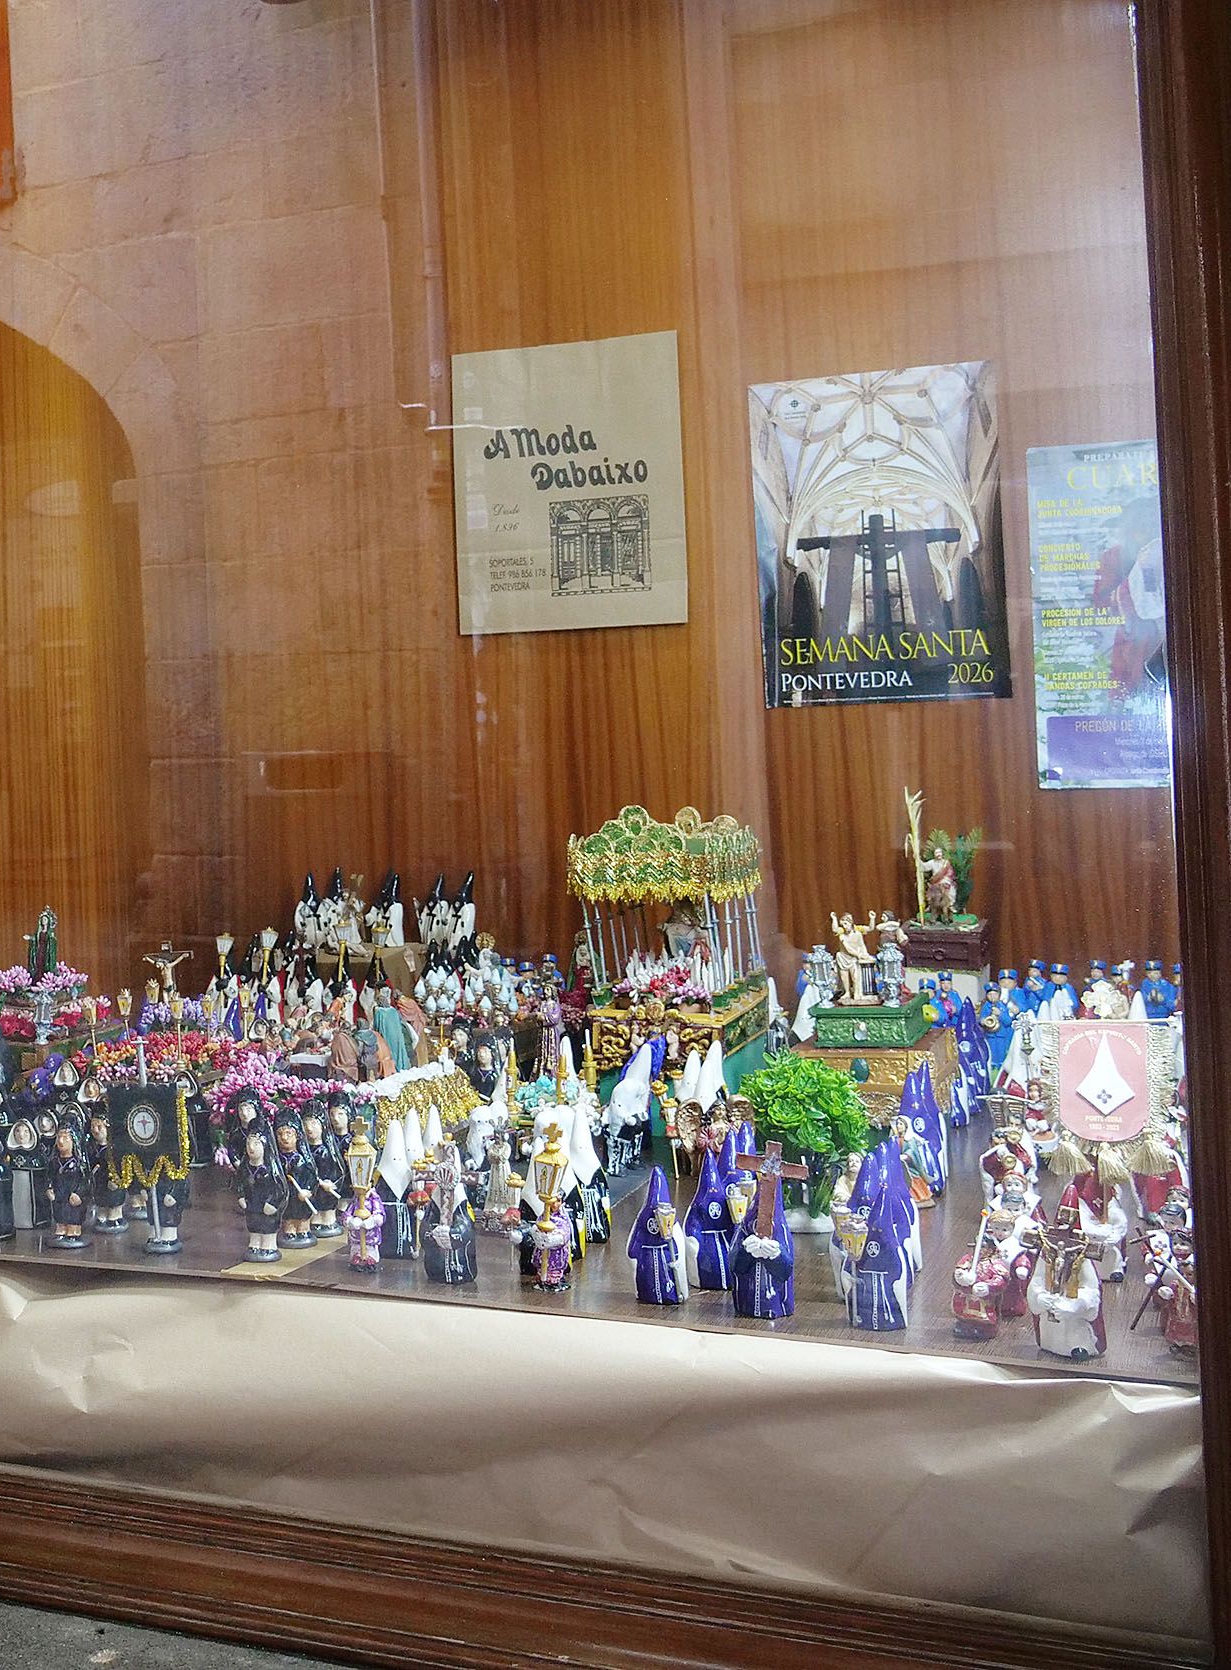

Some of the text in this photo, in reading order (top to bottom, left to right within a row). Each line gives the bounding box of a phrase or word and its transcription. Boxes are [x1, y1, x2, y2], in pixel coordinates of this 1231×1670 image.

[483, 424, 598, 459] A Moda
[531, 457, 648, 491] Dabaixo
[490, 581, 530, 593] PONTEVEDRA
[780, 628, 992, 666] SEMANA SANTA
[780, 669, 913, 692] PONTEVEDRA
[947, 662, 995, 685] 2026
